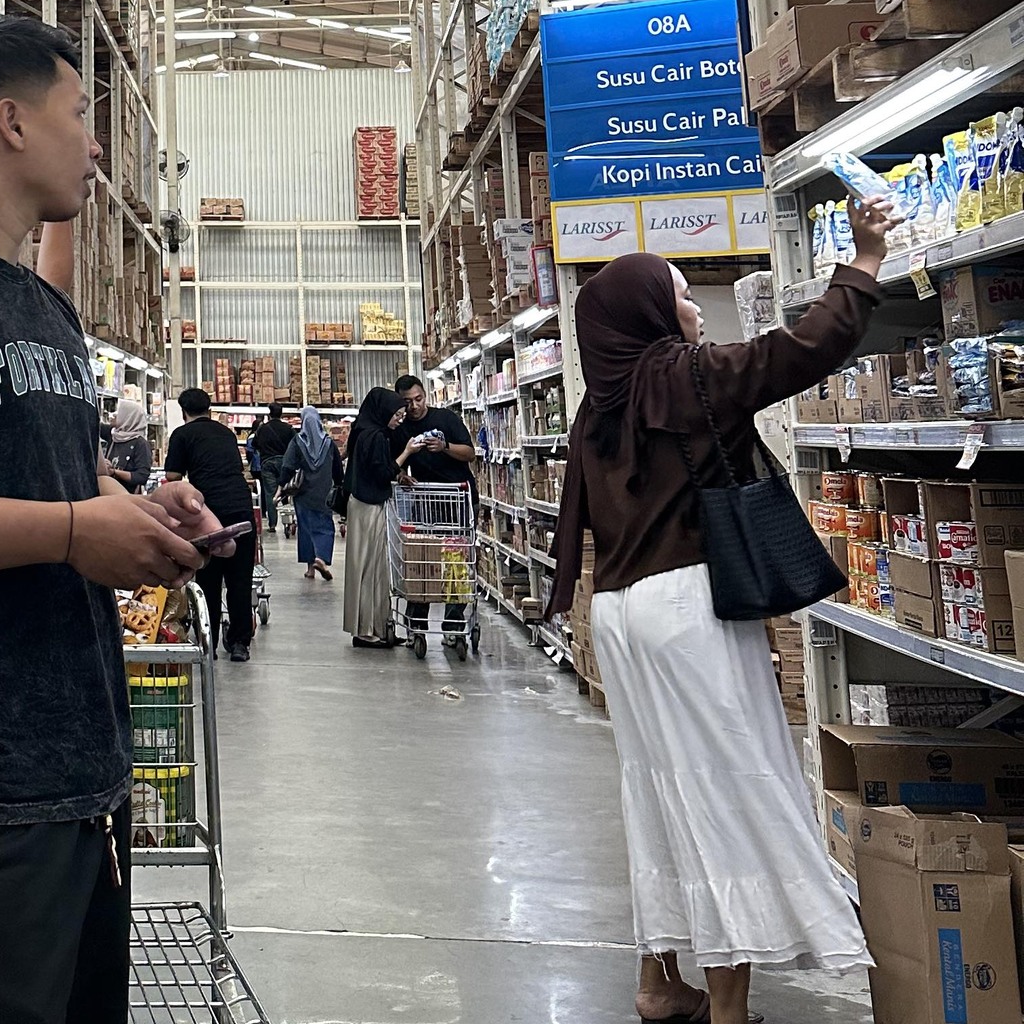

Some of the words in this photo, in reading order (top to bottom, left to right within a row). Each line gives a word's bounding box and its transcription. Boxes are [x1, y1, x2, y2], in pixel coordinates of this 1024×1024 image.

[596, 70, 646, 89] Susu
[650, 63, 694, 83] Cair
[700, 59, 742, 77] Bot
[607, 116, 657, 136] Susu
[663, 110, 706, 131] Cair
[602, 164, 650, 188] Kopi
[656, 160, 720, 181] Instan
[726, 155, 764, 175] Cai
[562, 221, 626, 236] LARISST
[650, 214, 717, 231] LARISST
[999, 625, 1013, 636] 12
